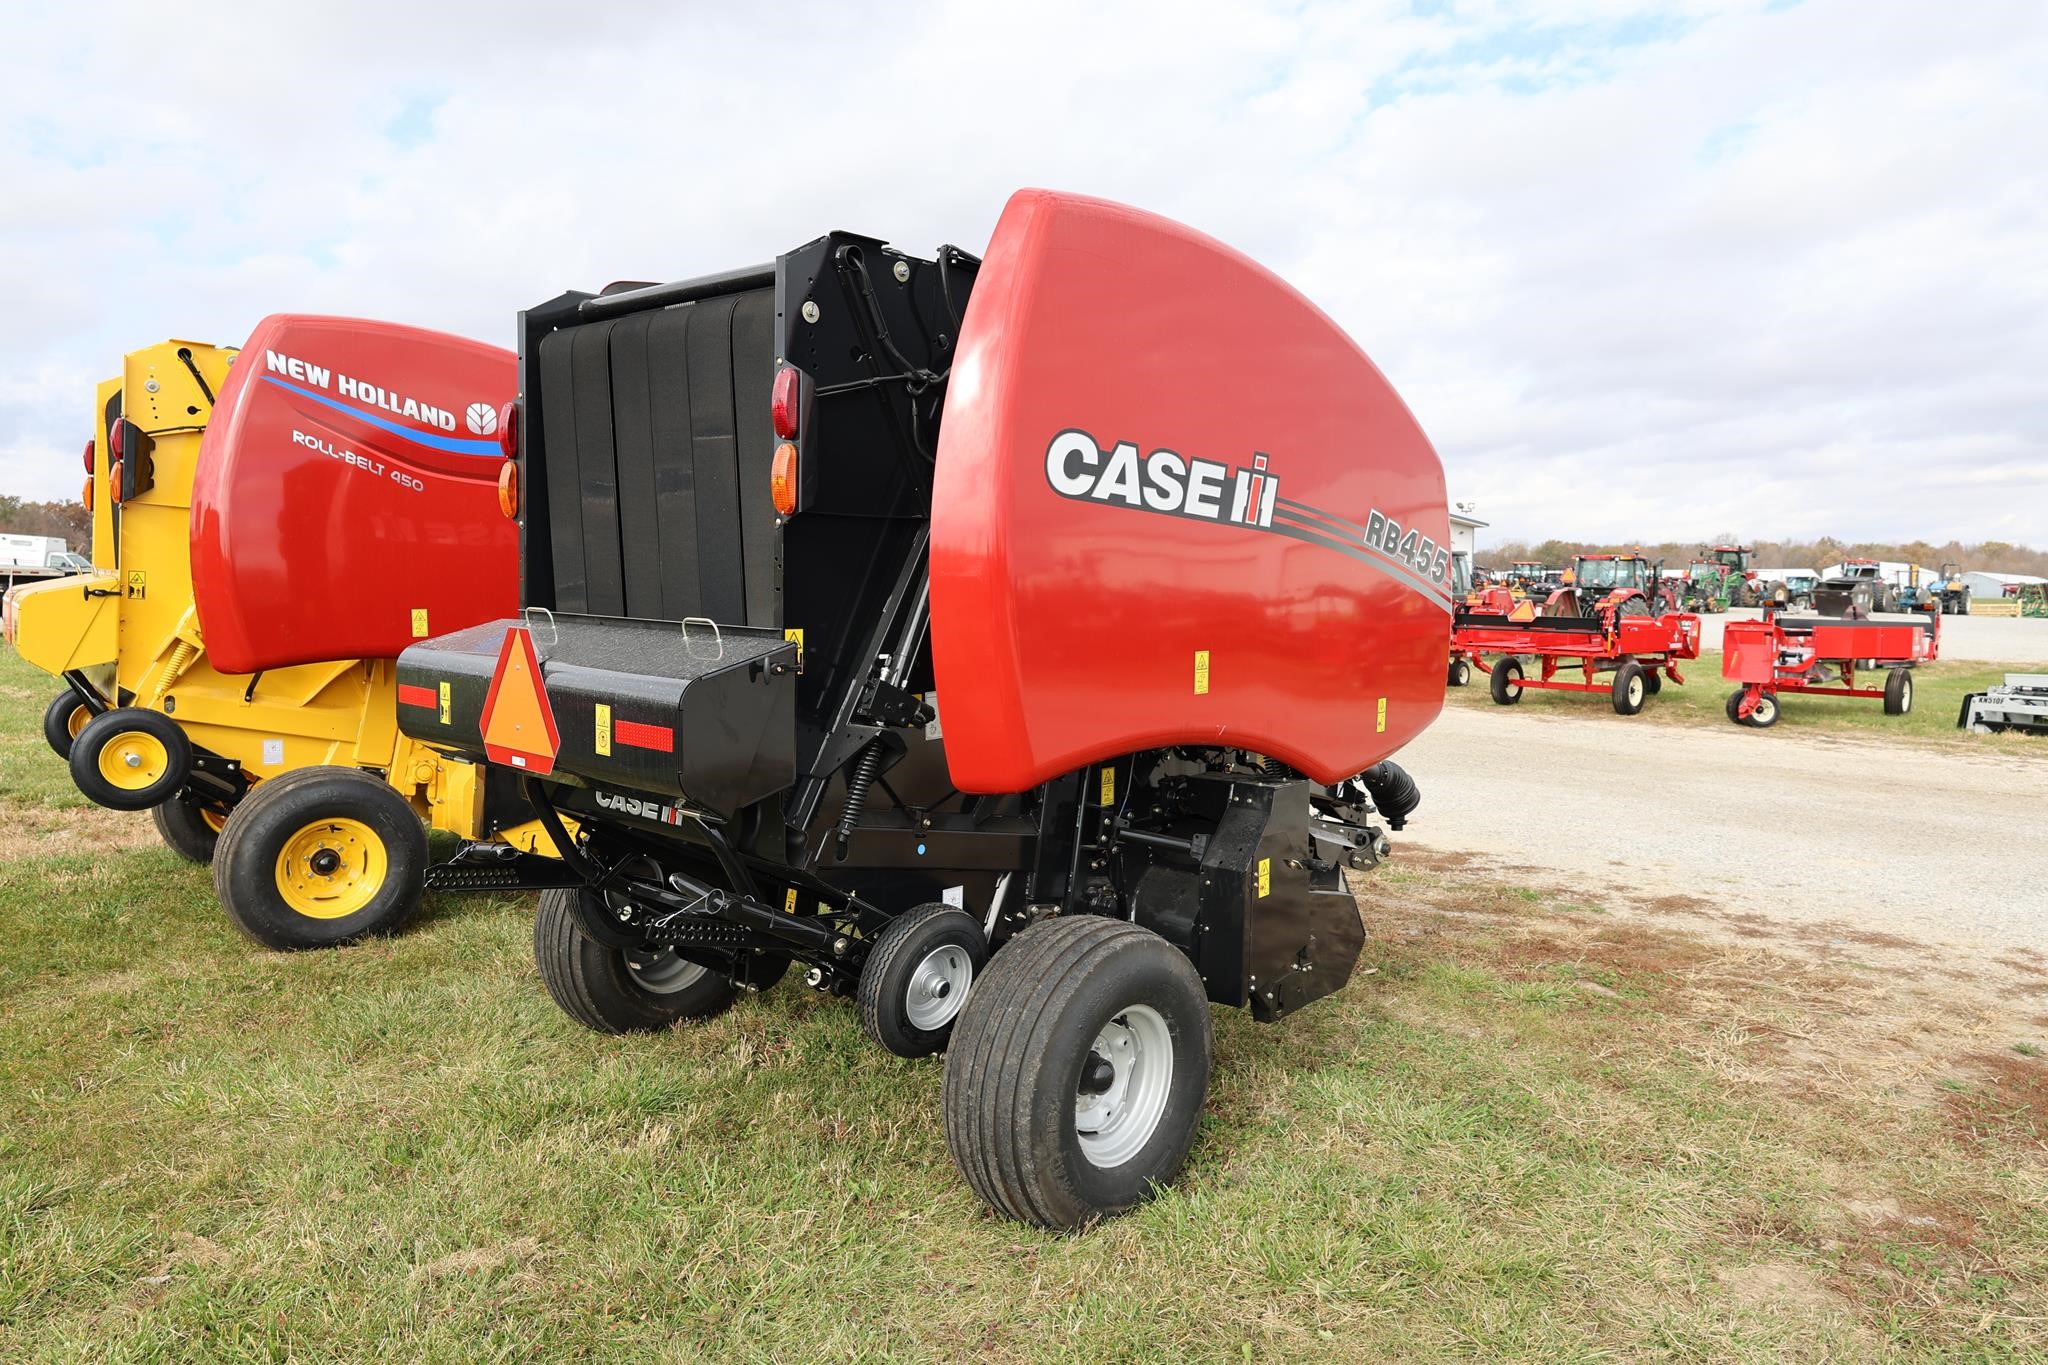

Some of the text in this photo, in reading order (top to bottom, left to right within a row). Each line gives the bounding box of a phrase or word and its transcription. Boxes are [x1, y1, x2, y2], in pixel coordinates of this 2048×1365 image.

[265, 349, 457, 432] NEW HOLLAND
[292, 430, 424, 492] ROLL-BELT 450
[1046, 431, 1227, 519] CASE
[1363, 508, 1449, 585] RB455
[595, 790, 659, 820] CASE
